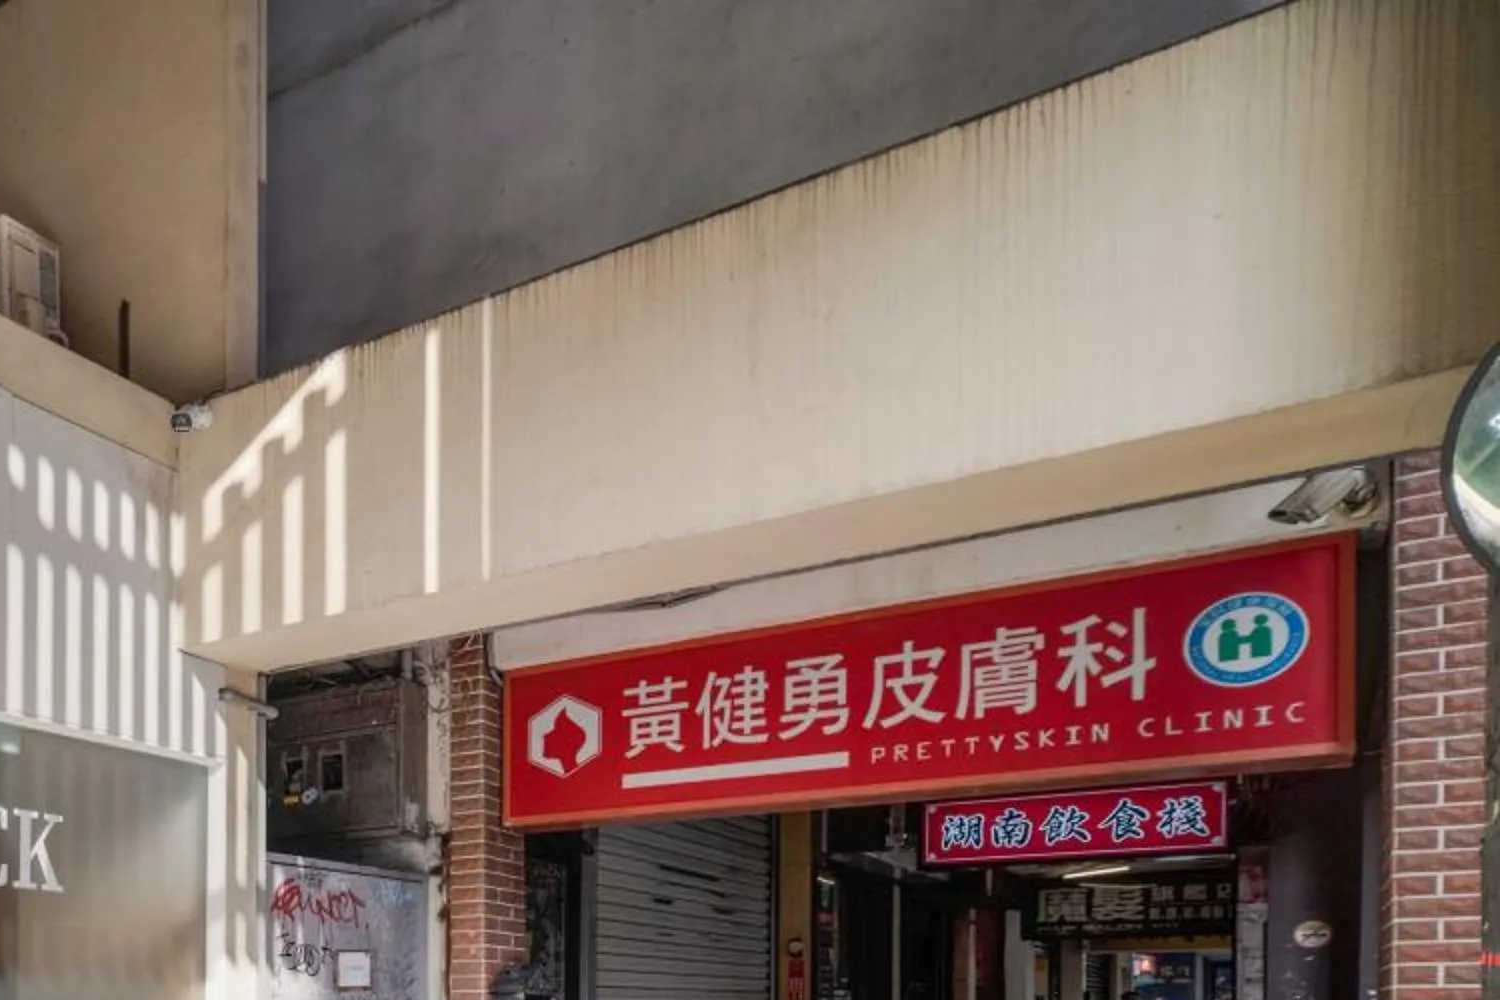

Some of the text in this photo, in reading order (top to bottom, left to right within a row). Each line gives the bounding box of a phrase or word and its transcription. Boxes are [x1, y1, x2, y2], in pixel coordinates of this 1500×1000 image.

[621, 607, 1157, 759] 黃健勇皮膚科
[871, 701, 1306, 765] PRETTYSKIN CLINIC
[940, 796, 1210, 851] 湖南飲食棧
